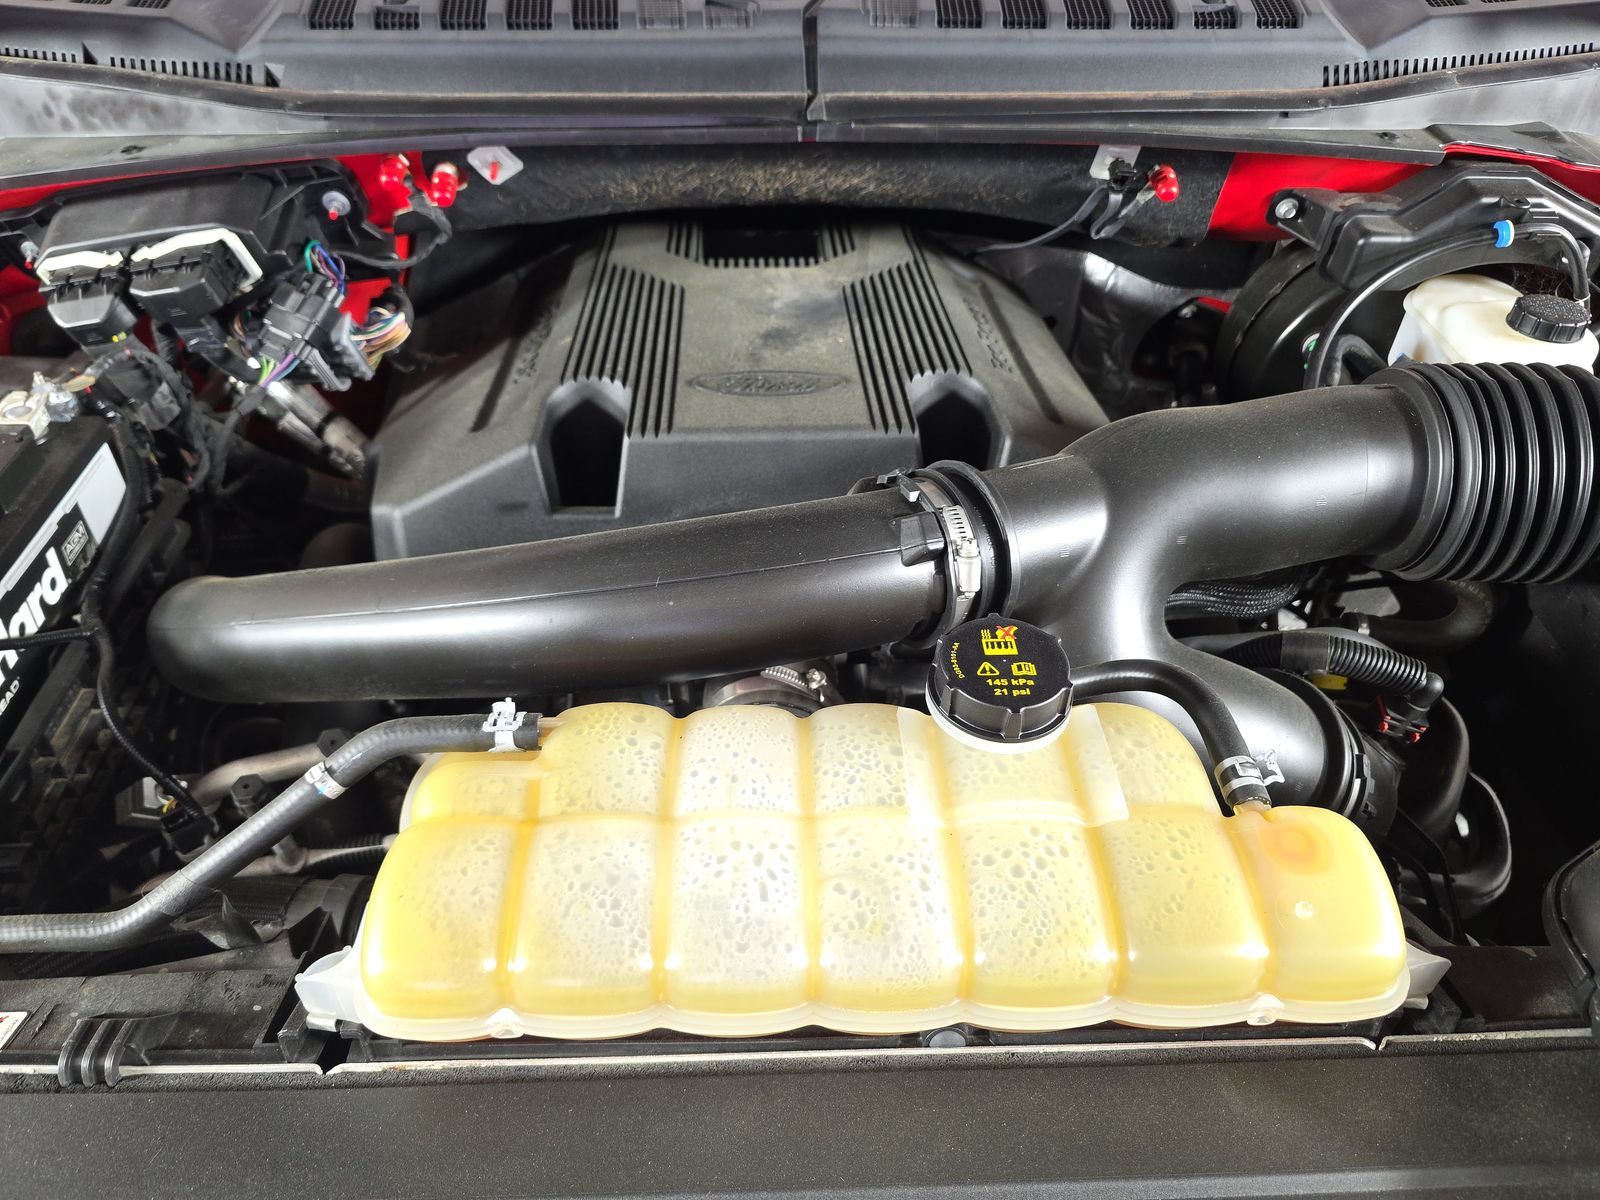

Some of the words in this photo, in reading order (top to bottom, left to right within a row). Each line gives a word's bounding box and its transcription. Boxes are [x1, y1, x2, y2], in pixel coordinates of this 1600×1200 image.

[64, 525, 84, 556] AGM
[986, 678, 1008, 686] 145
[1010, 678, 1035, 686] kPa
[993, 688, 1008, 696] 21
[1012, 687, 1031, 697] psi
[0, 679, 20, 716] EAD
